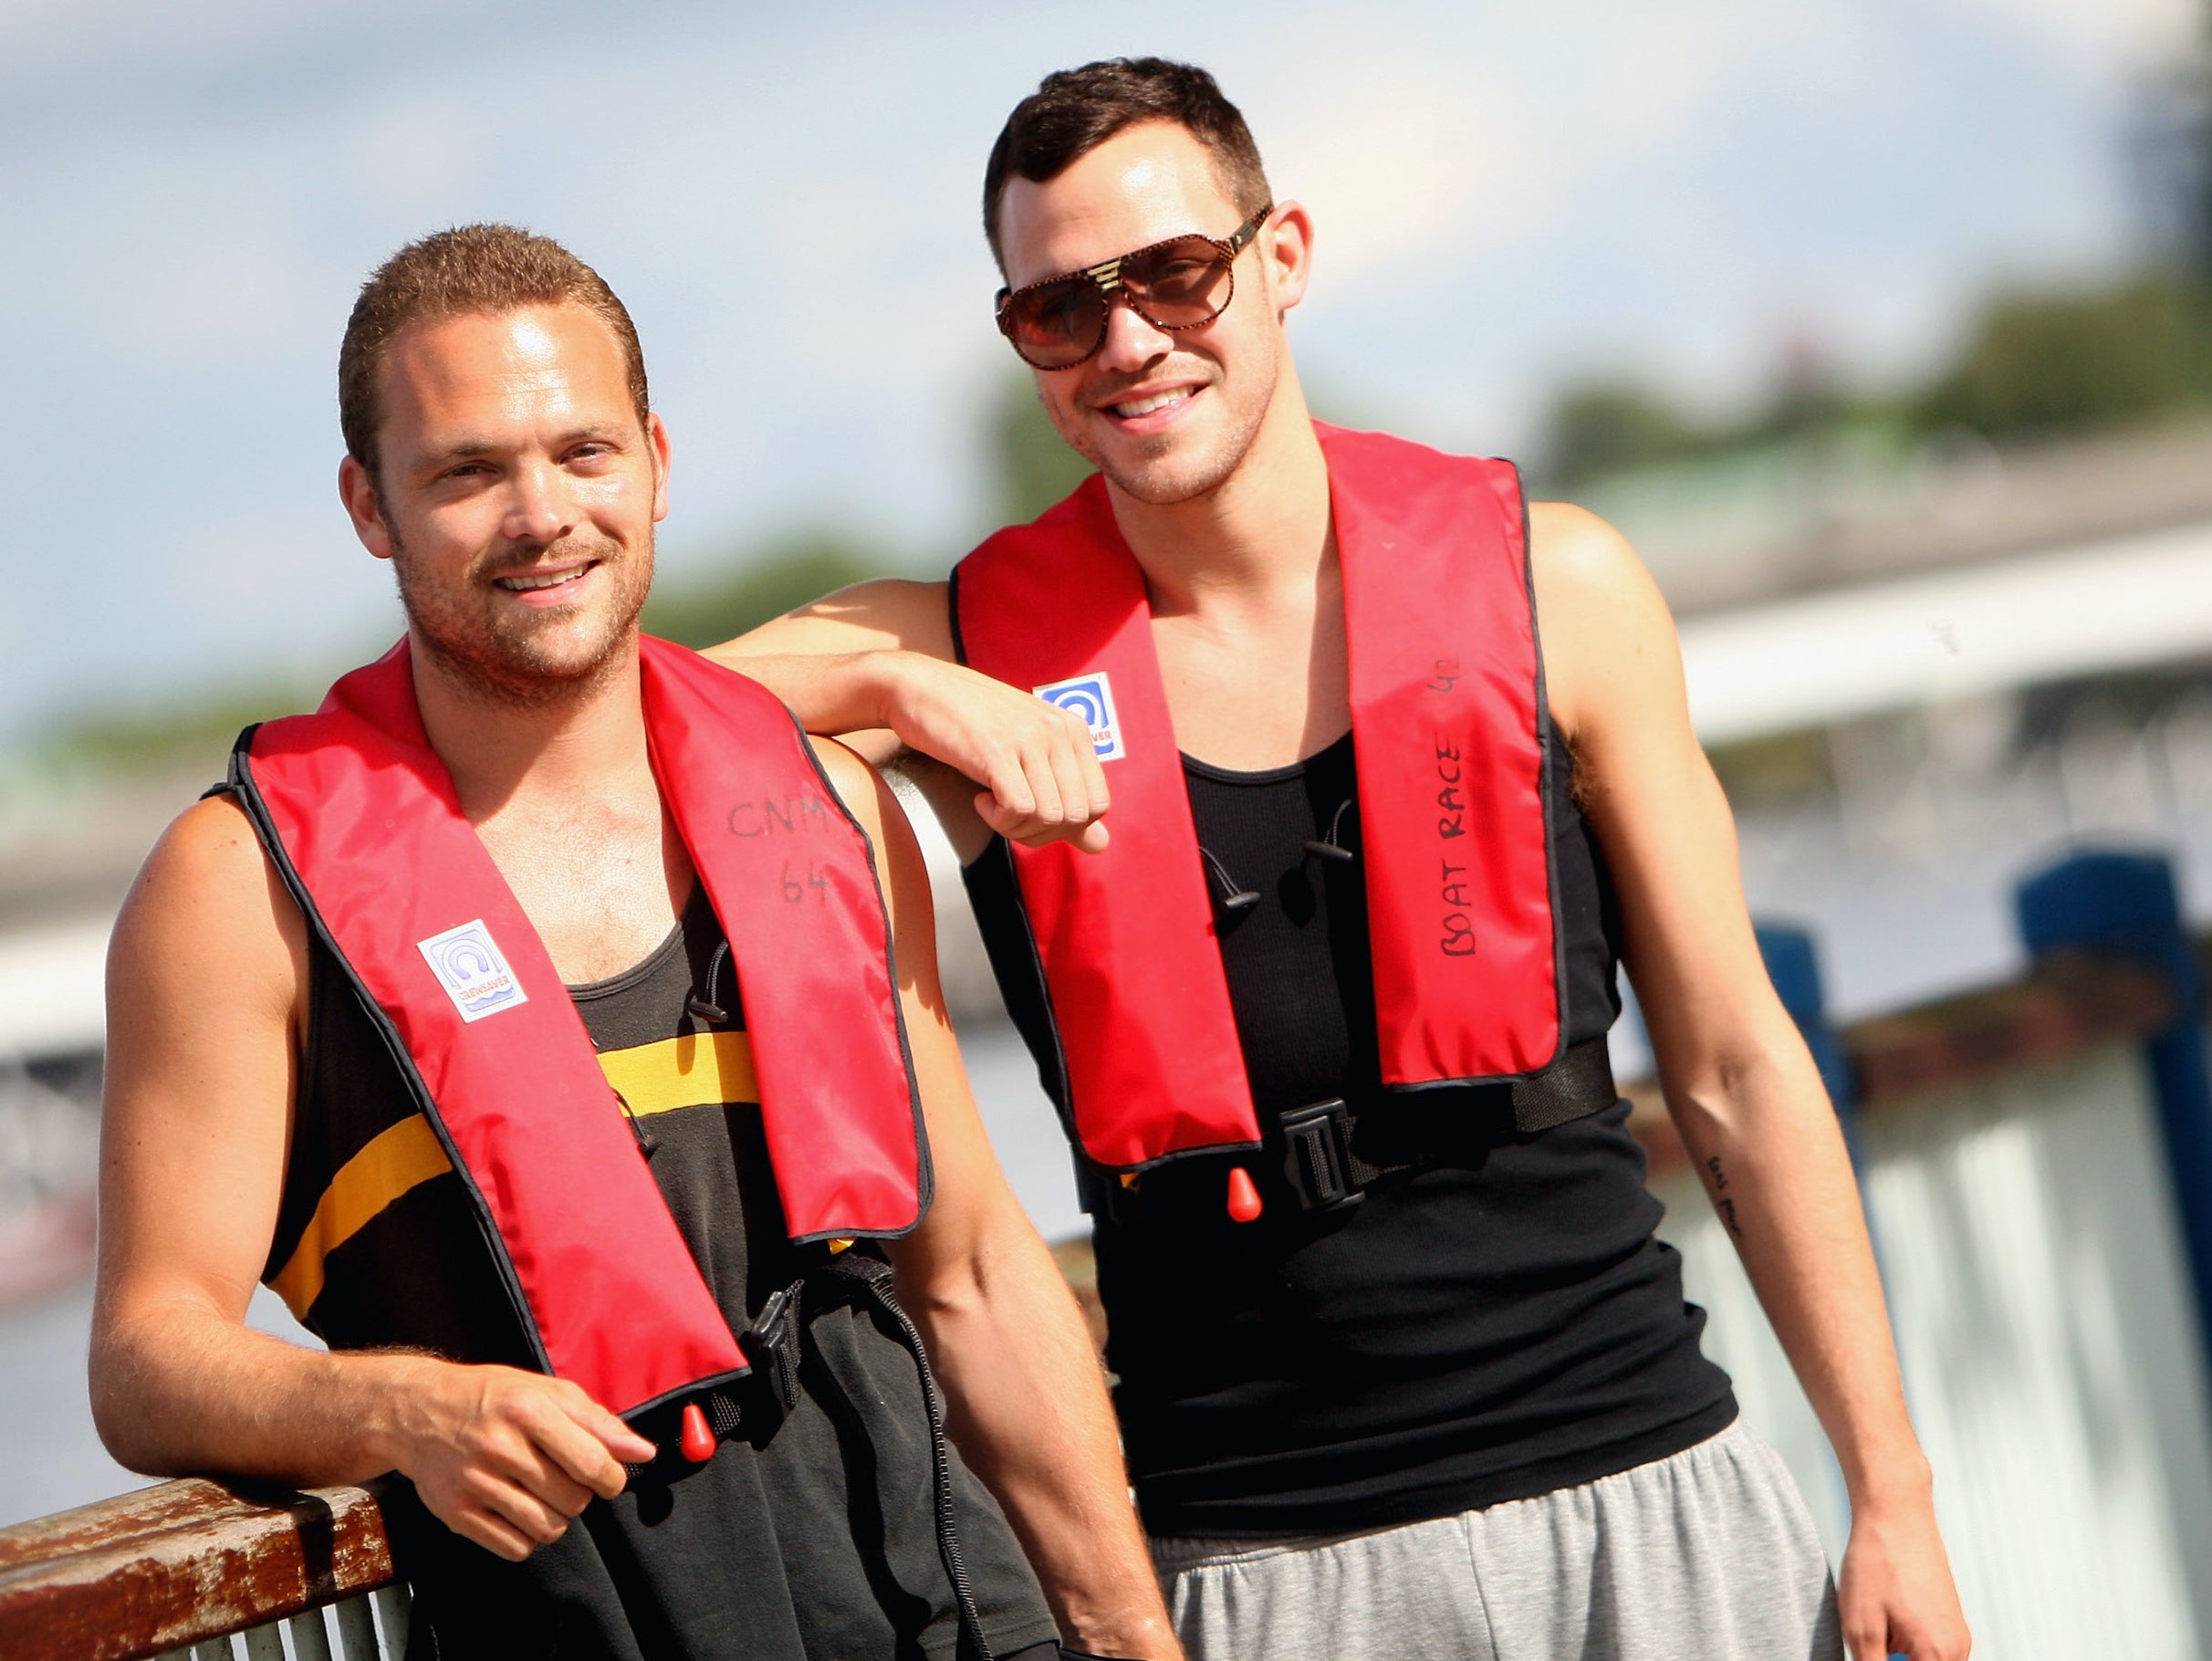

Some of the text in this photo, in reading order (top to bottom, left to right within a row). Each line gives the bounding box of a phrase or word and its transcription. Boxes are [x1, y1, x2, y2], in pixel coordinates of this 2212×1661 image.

[729, 796, 829, 837] CNM
[1435, 731, 1466, 840] RACE
[782, 860, 829, 907] 64
[1441, 859, 1476, 956] BOAT
